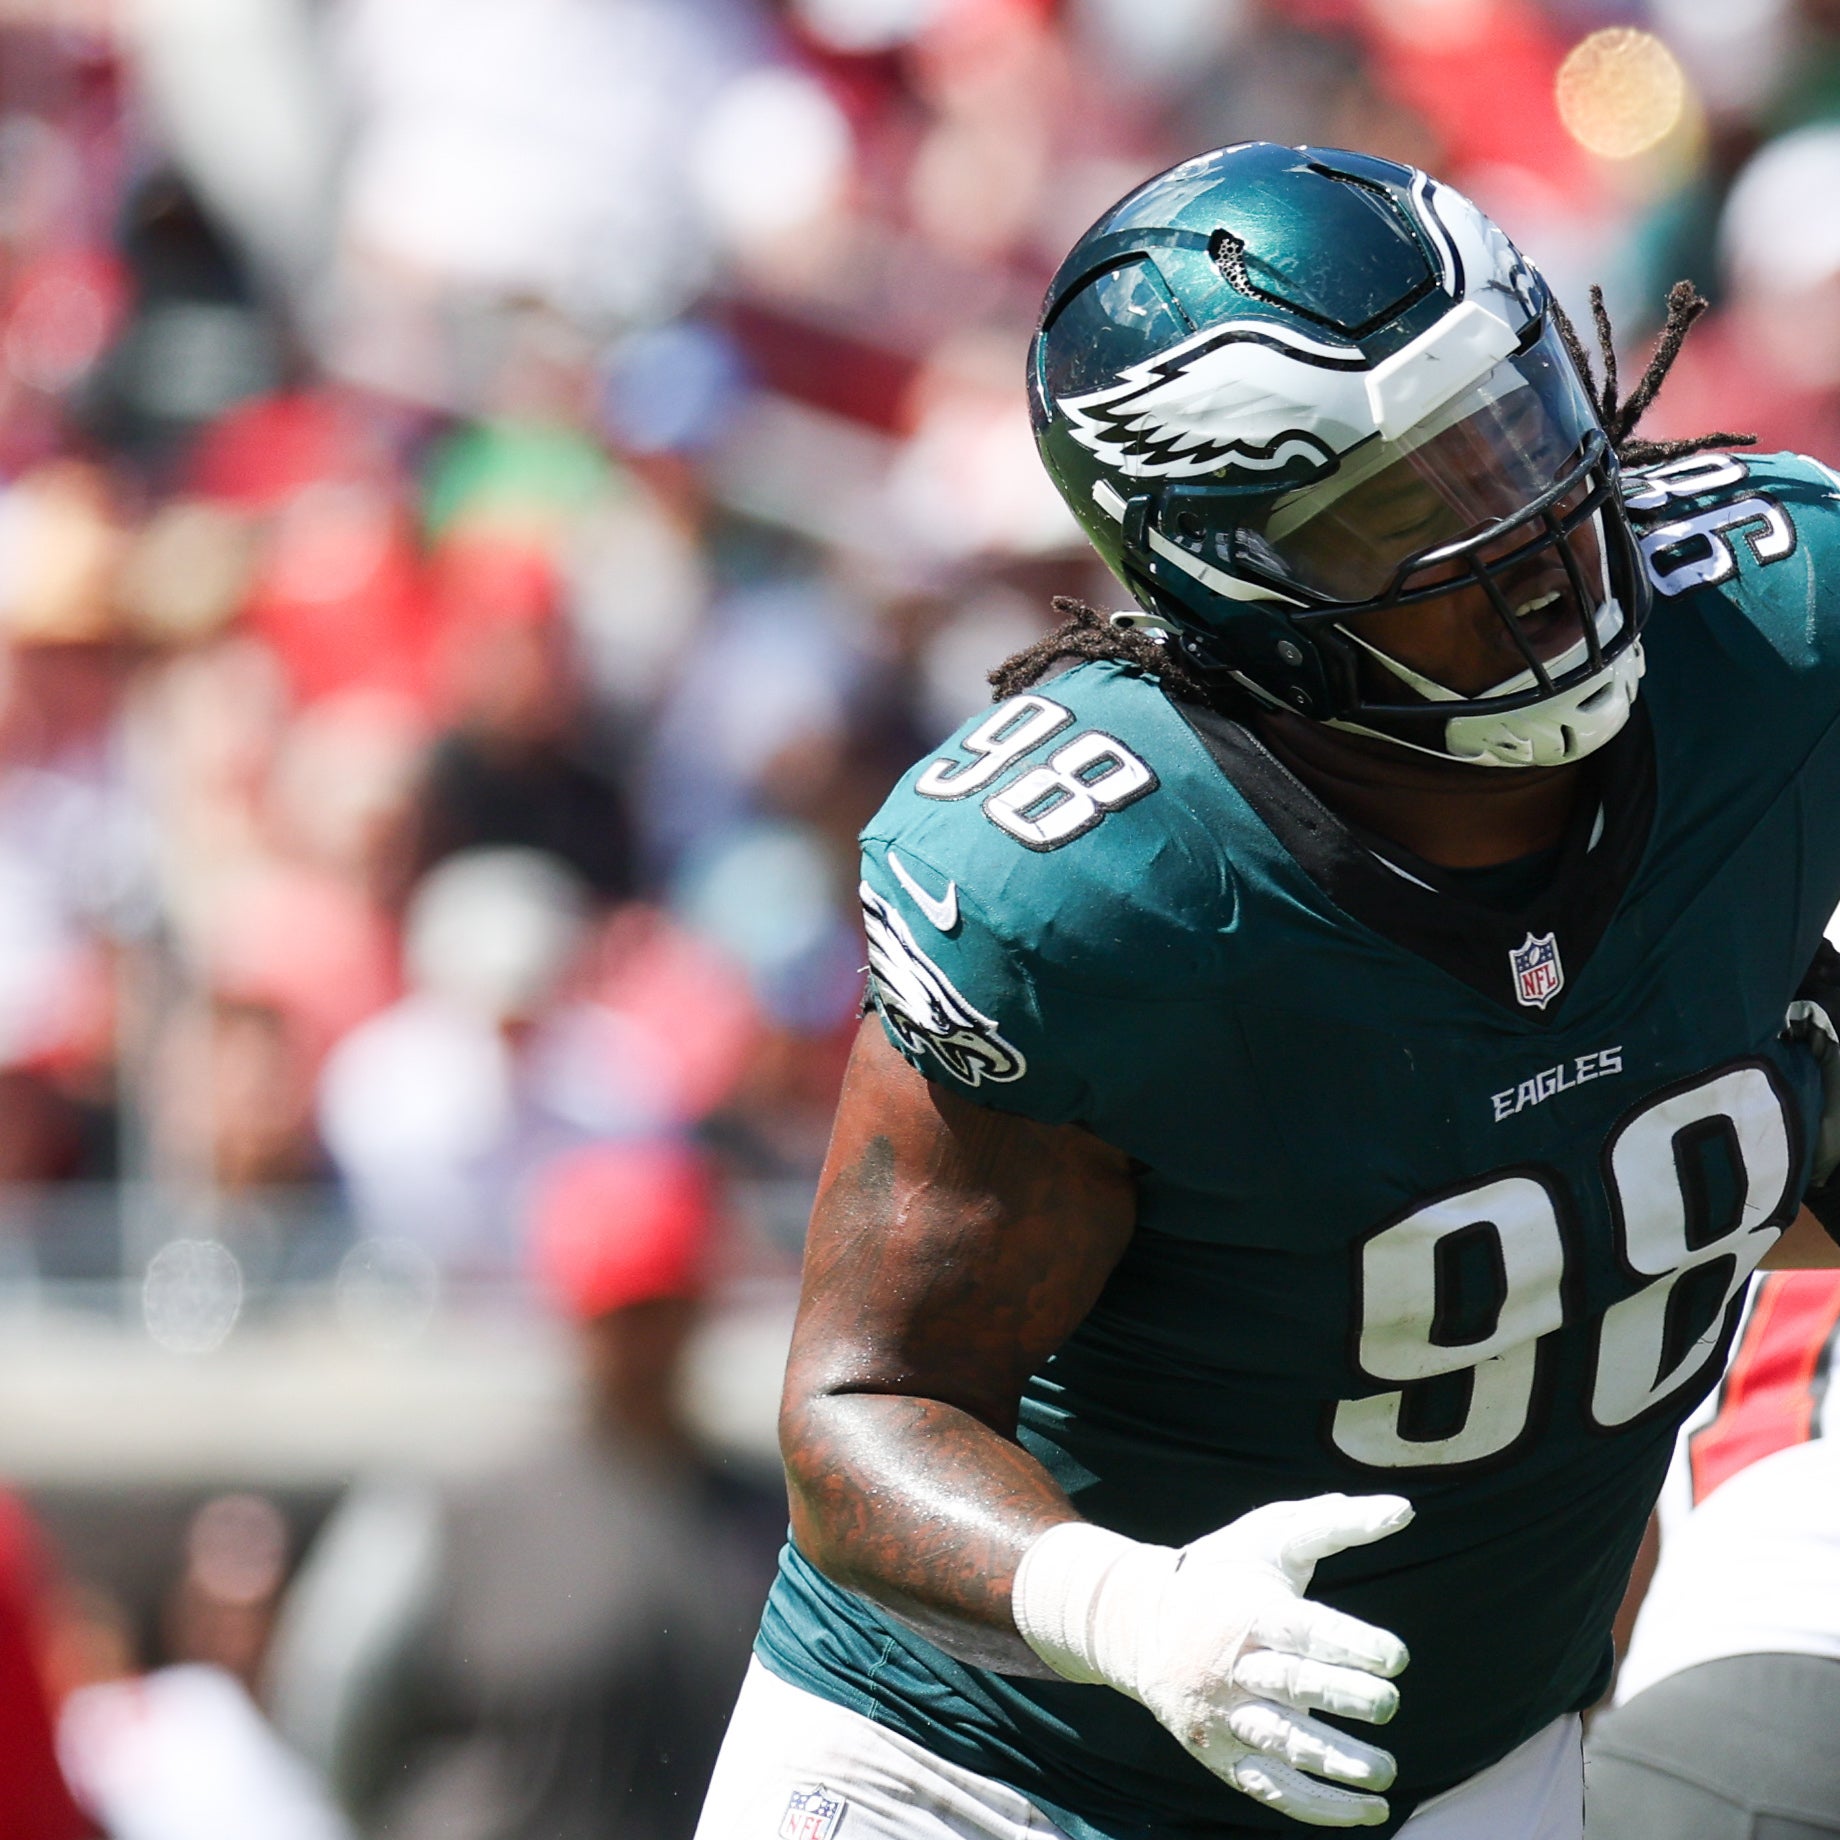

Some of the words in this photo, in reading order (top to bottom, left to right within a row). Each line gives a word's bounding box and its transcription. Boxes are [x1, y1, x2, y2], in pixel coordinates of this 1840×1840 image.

[912, 694, 1162, 853] 98
[1521, 963, 1557, 997] NFL
[1490, 1045, 1624, 1123] EAGLES
[1324, 1058, 1797, 1474] 98
